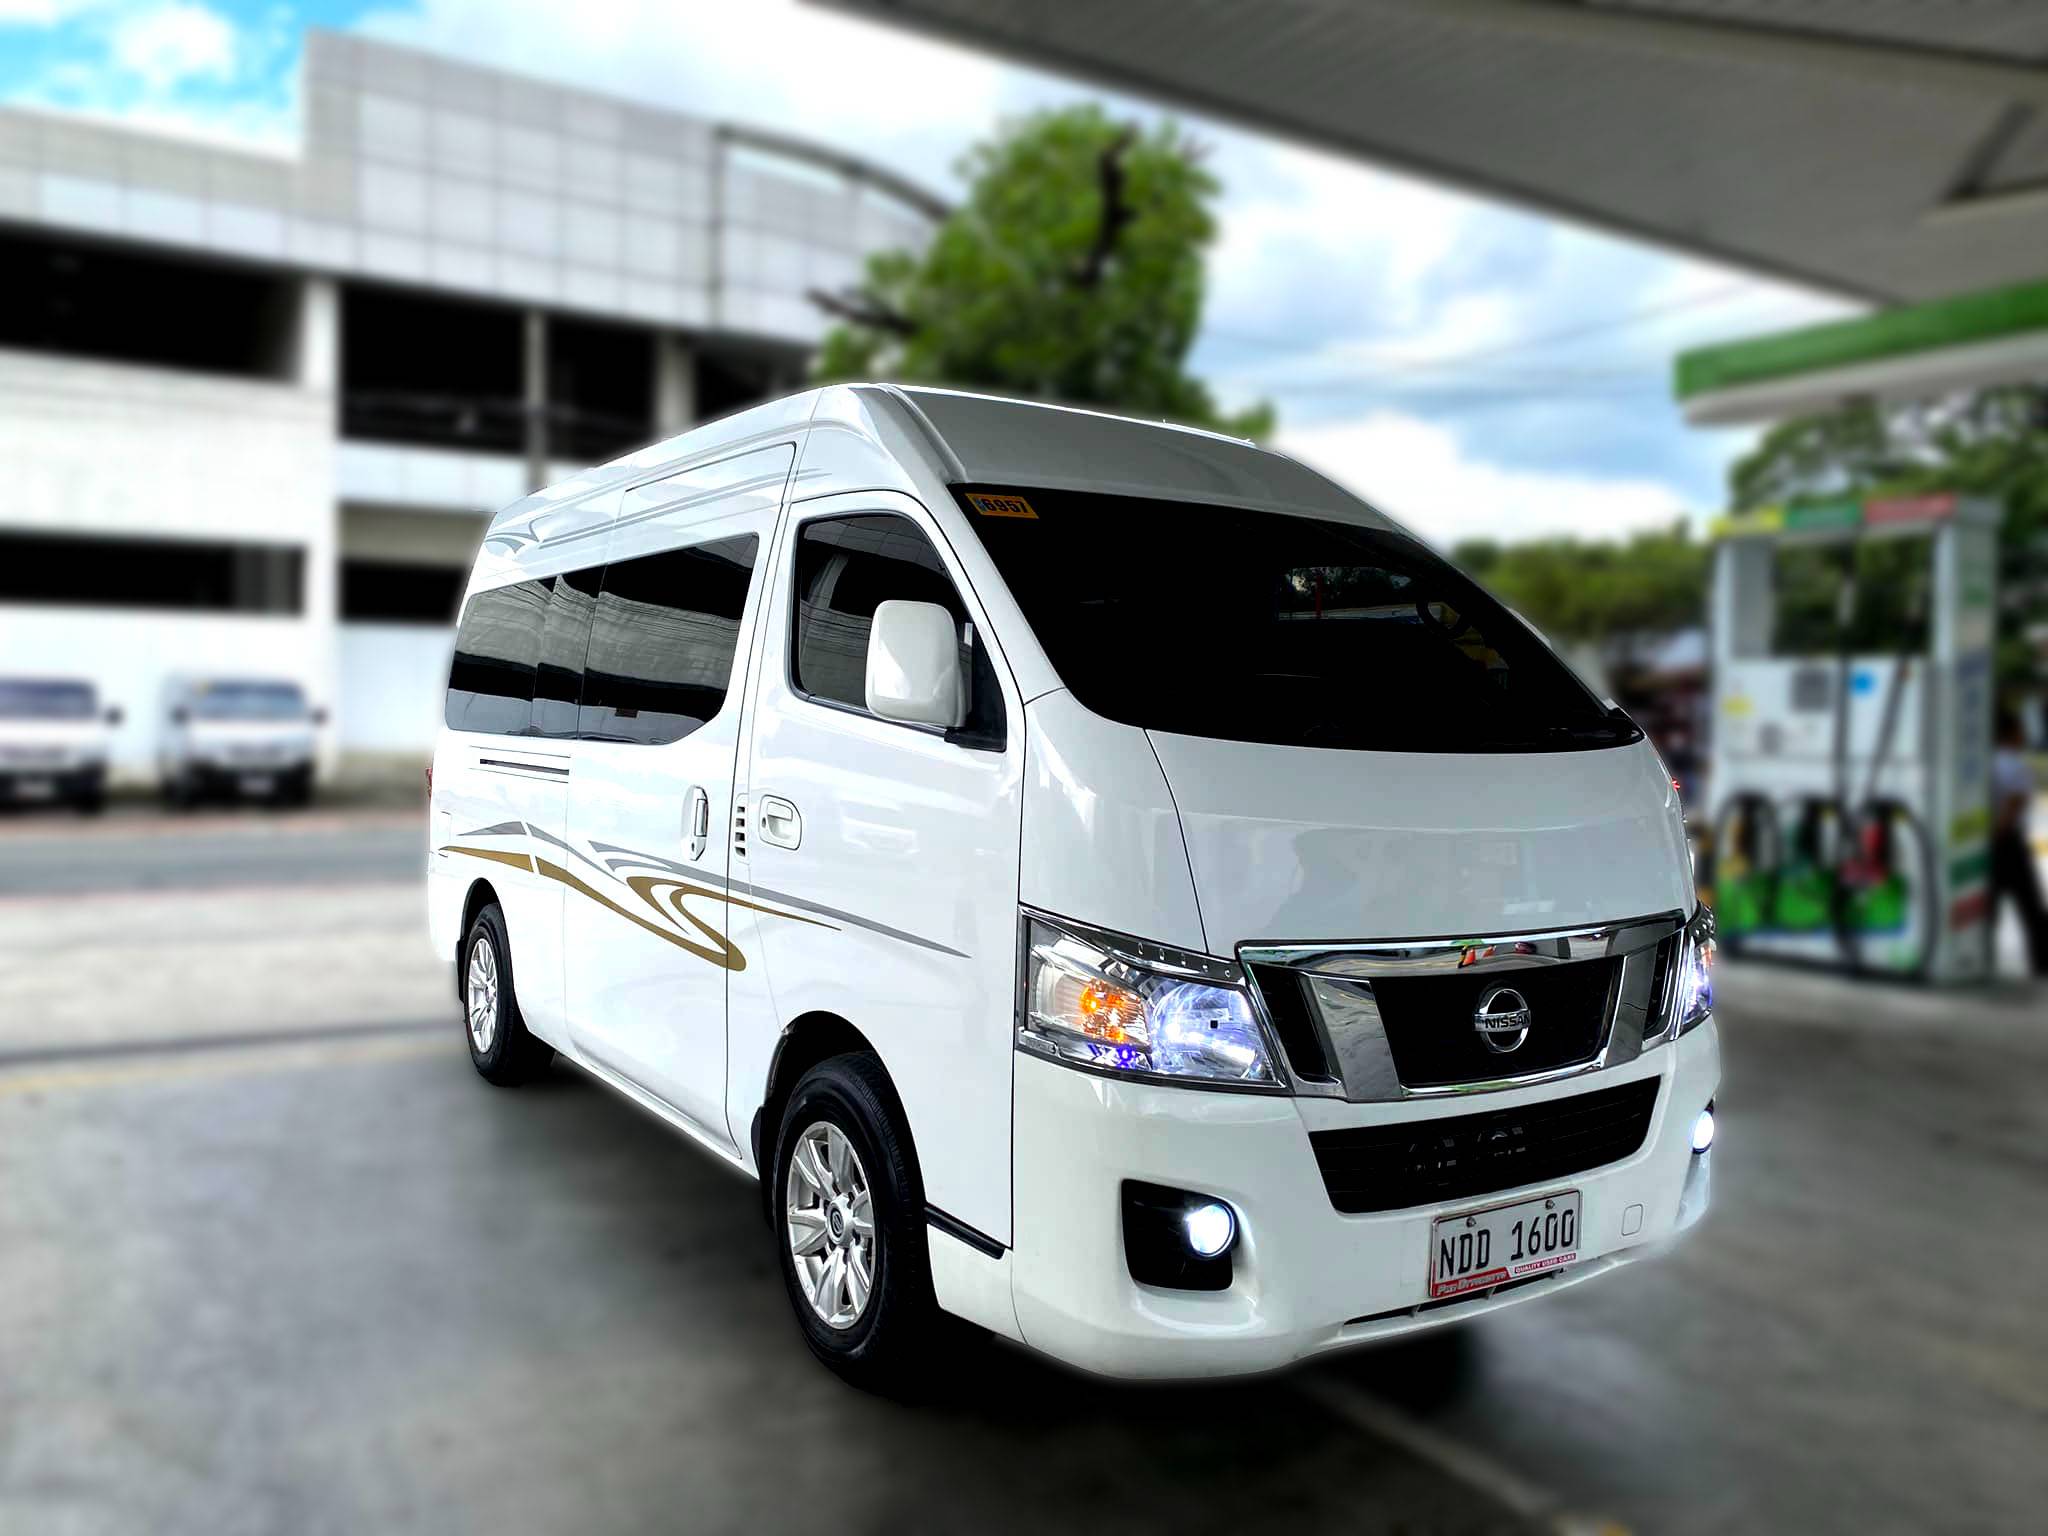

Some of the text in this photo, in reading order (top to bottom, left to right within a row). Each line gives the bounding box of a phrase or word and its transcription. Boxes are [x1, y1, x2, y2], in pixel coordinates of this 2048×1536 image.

[1485, 1014, 1529, 1028] NISSAN
[1440, 1209, 1574, 1279] NDD 1600
